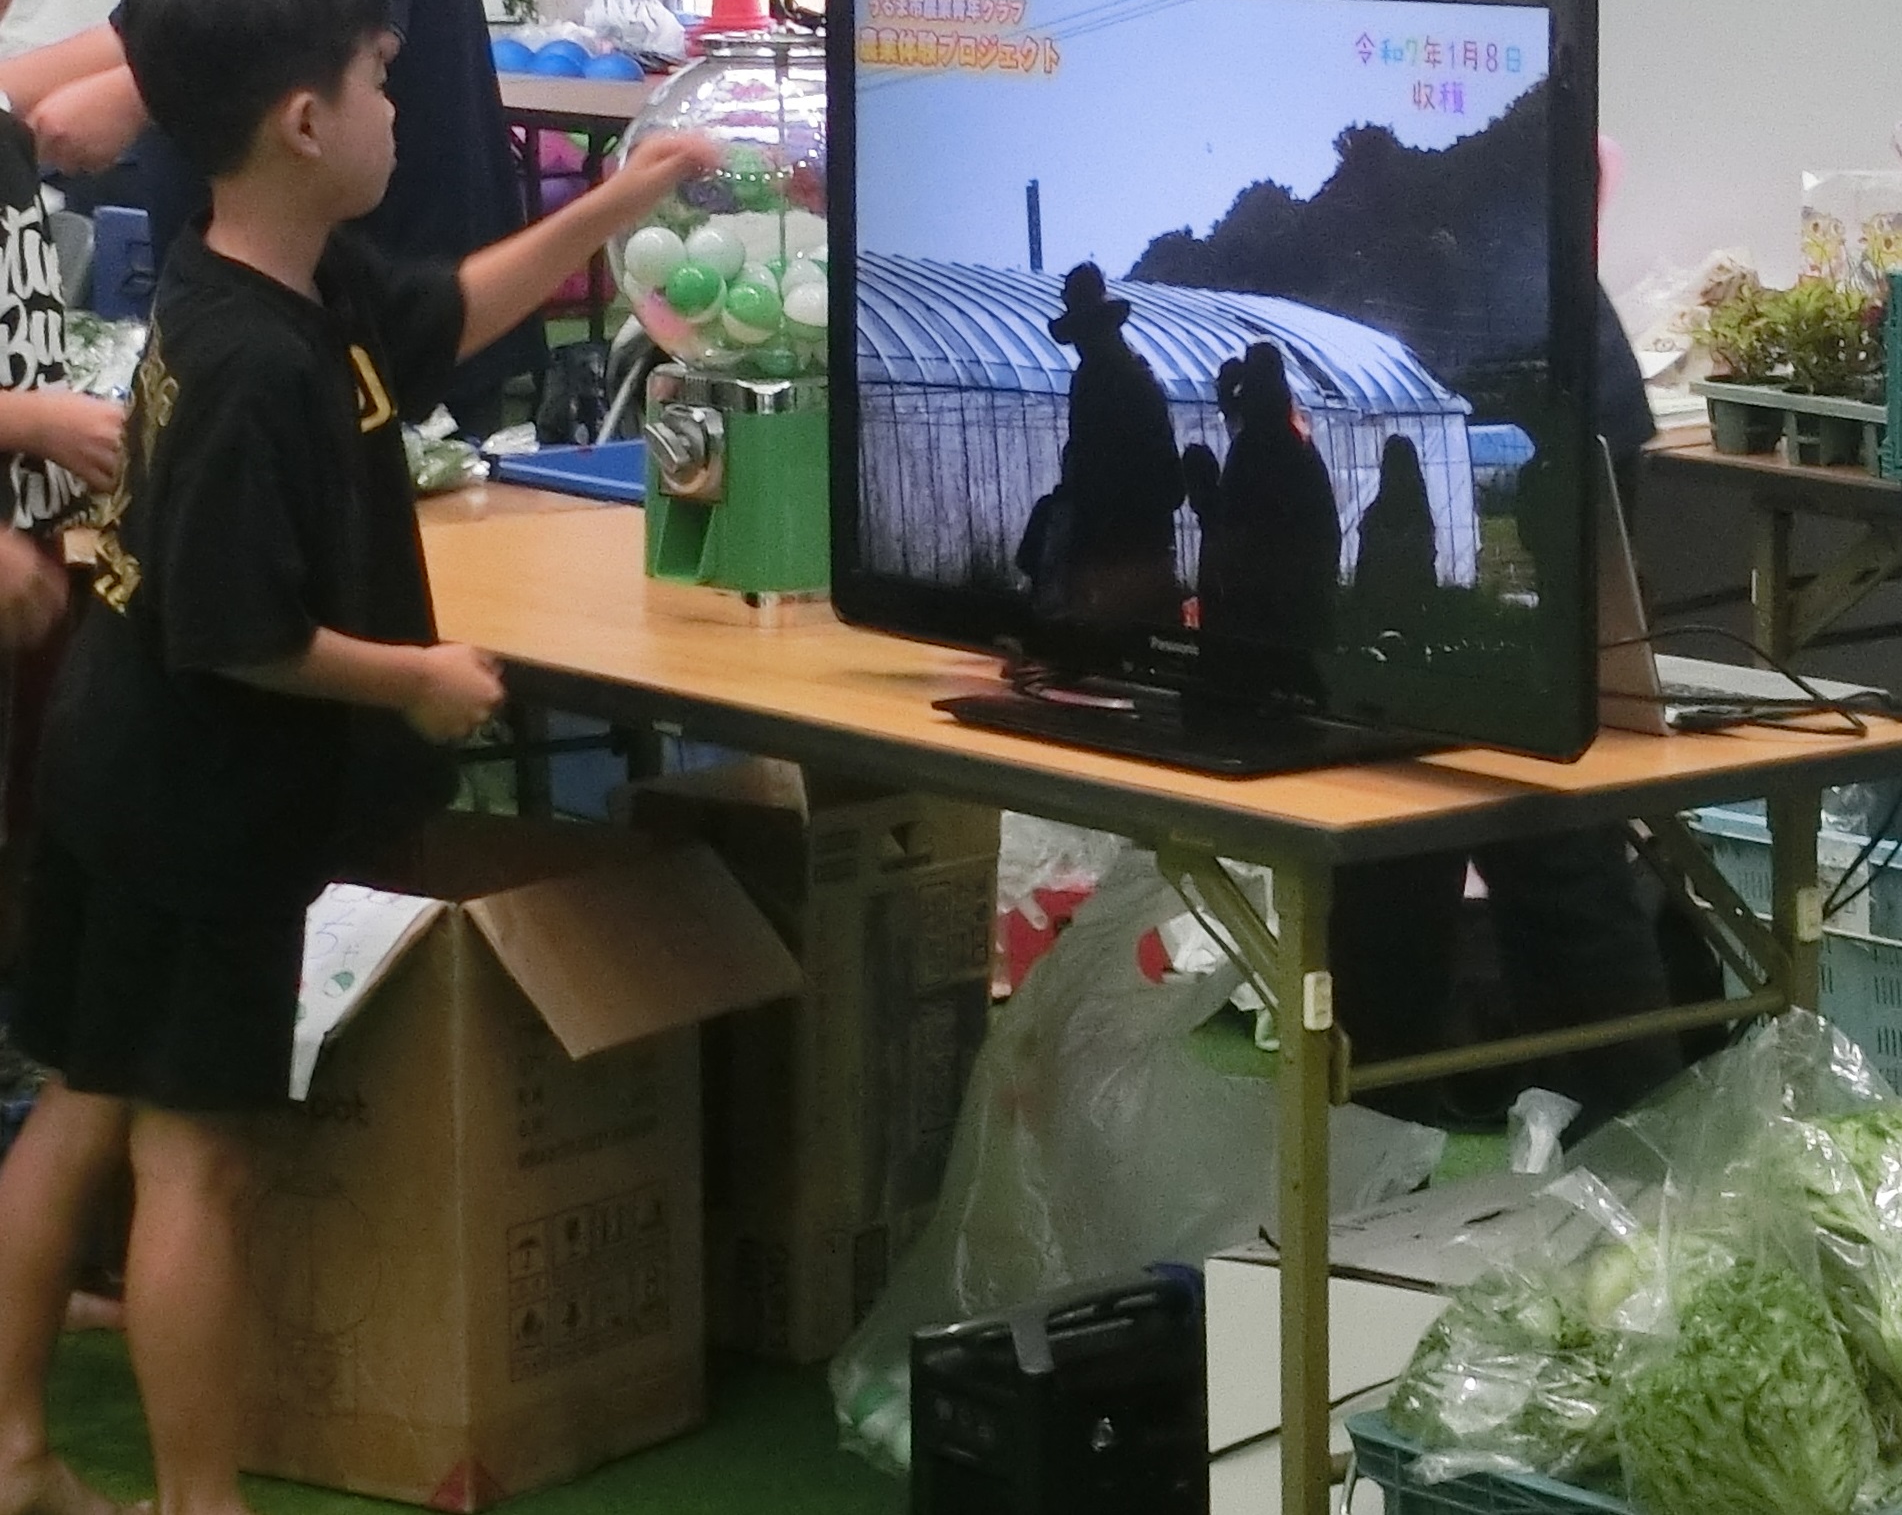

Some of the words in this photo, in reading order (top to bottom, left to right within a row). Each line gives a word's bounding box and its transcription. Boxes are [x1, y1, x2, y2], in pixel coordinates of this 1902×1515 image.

[1356, 32, 1521, 73] 令和7年1月8日
